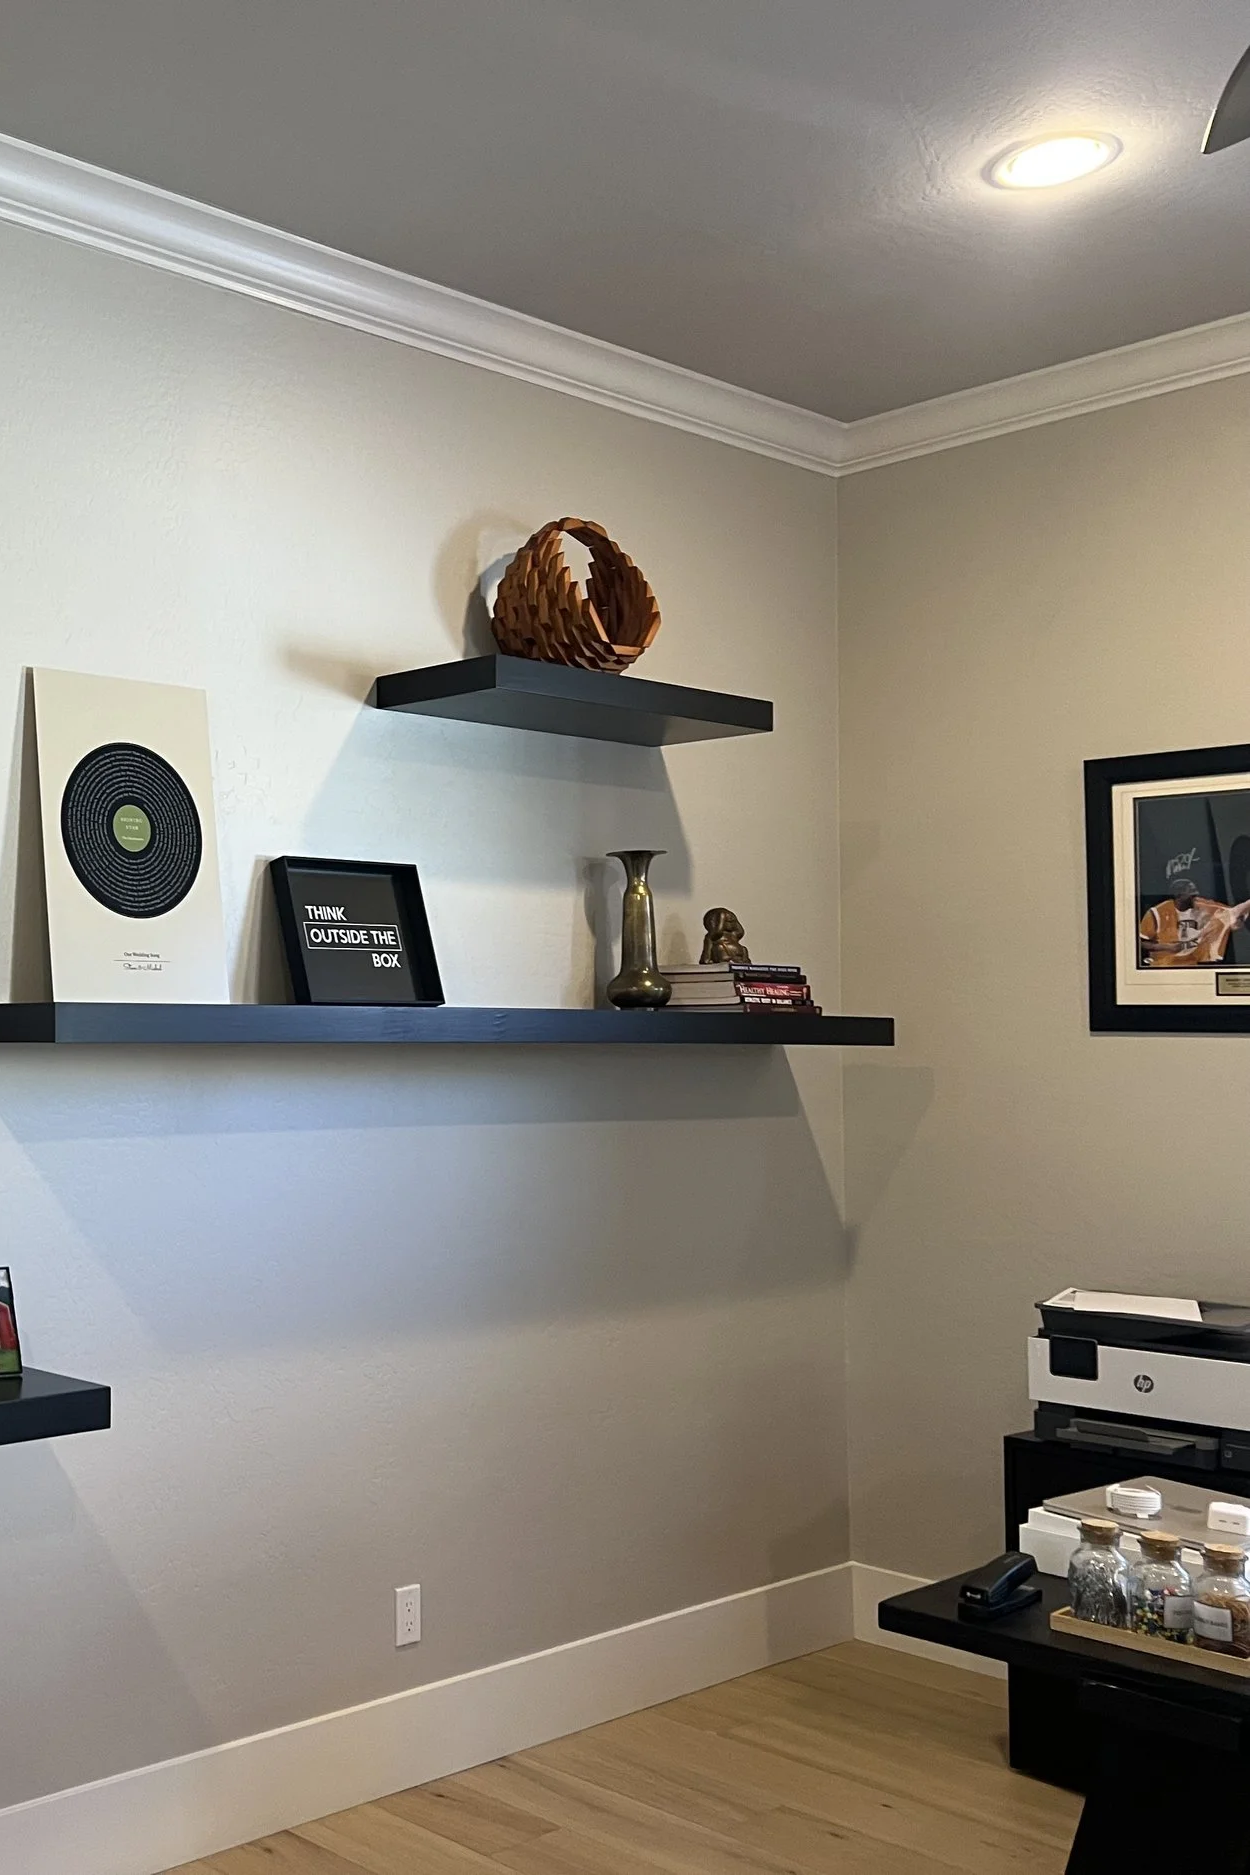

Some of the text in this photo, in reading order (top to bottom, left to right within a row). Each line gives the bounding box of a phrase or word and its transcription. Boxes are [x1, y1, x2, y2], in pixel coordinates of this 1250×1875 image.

[304, 905, 347, 921] THINK
[310, 928, 397, 945] OUTSIDE THE
[372, 953, 401, 968] BOX
[1135, 1375, 1153, 1393] hp
